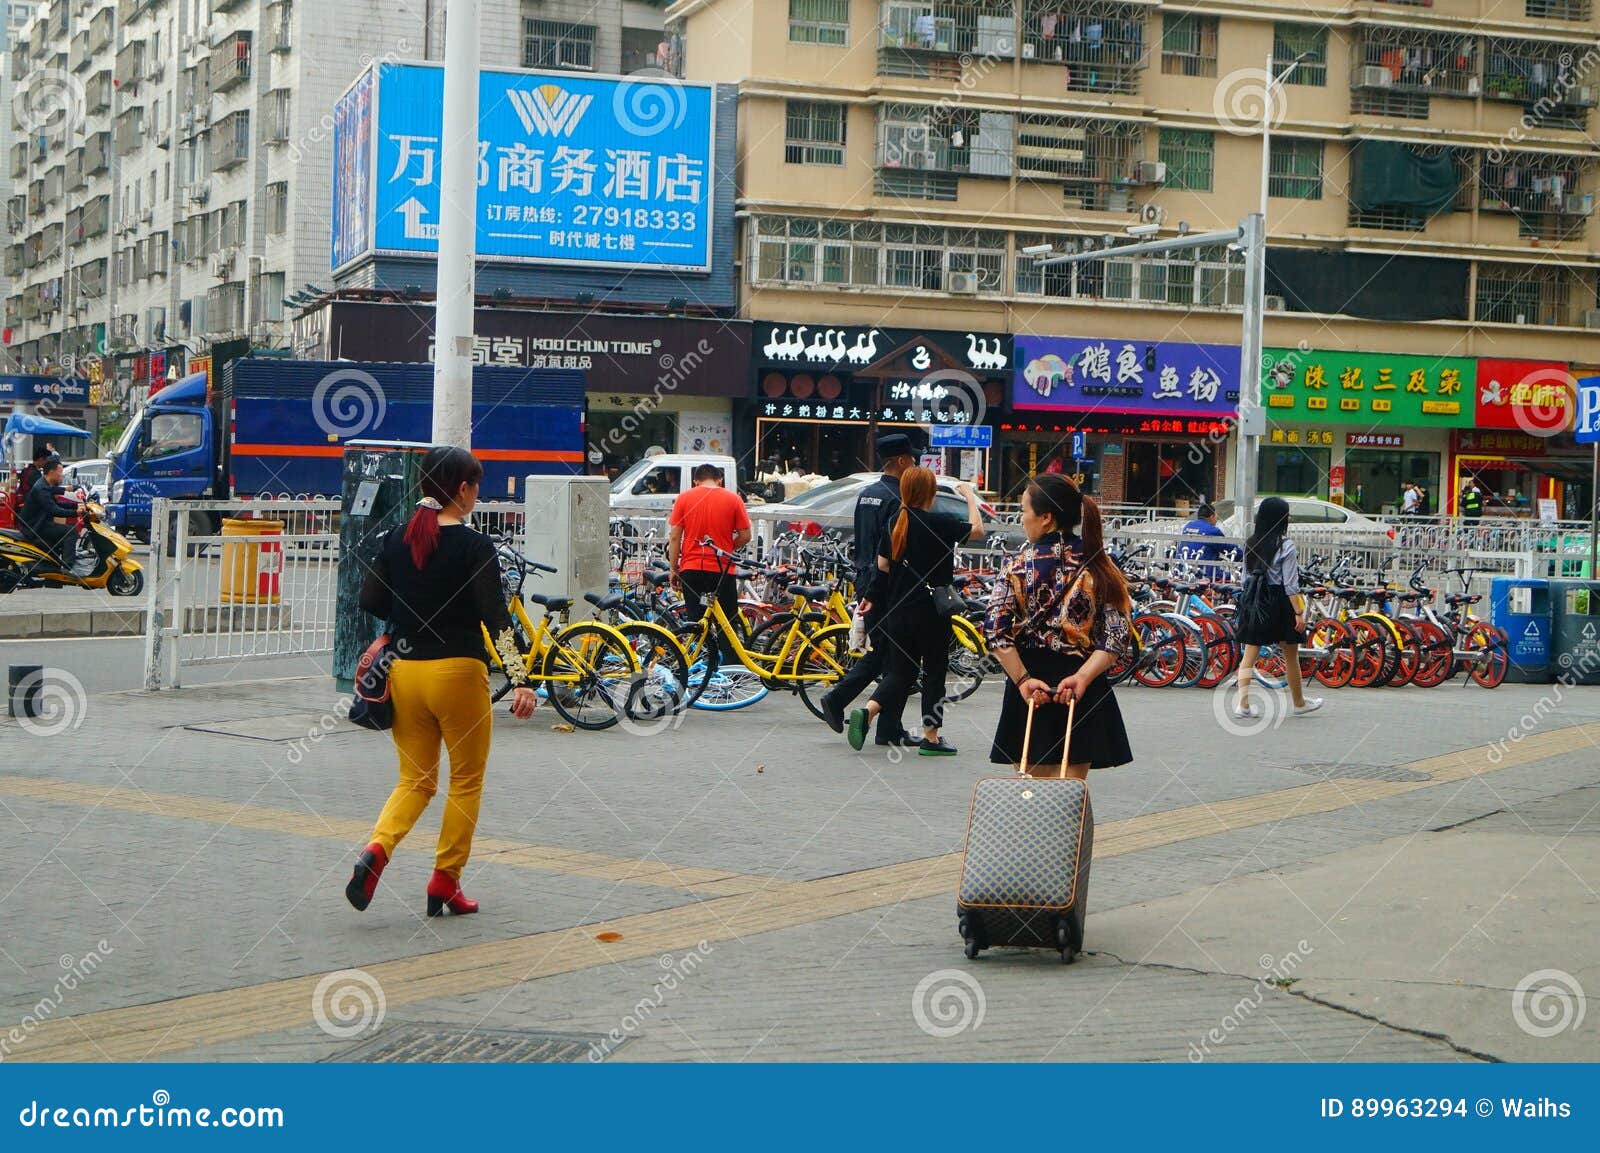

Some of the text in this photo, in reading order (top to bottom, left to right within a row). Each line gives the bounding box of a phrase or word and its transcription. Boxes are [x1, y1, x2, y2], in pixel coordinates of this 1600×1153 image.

[388, 134, 703, 204] 万商务酒店
[573, 205, 696, 231] 27918333
[549, 230, 636, 251] 时代城七楼
